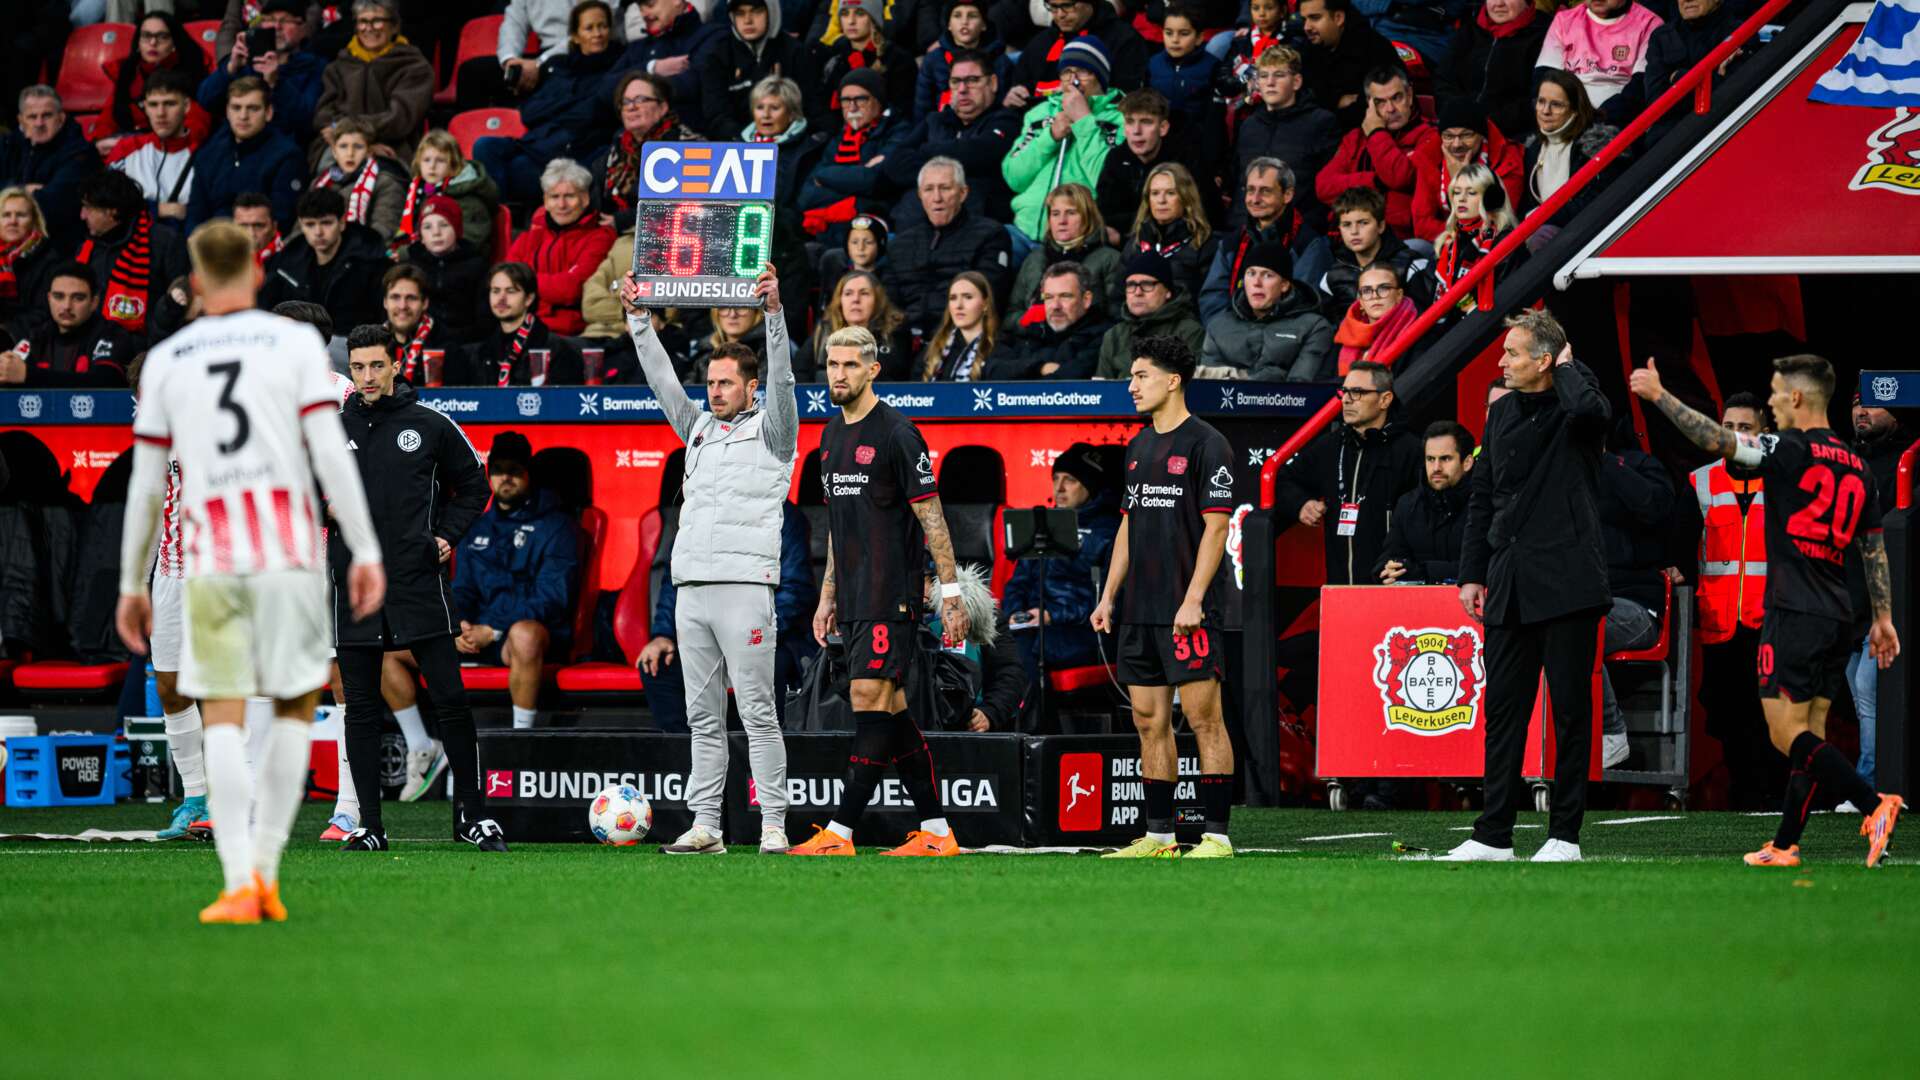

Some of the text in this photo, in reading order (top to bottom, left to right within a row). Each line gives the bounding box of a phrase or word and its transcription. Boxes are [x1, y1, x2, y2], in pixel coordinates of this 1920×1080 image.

[644, 148, 774, 193] CEAT
[670, 206, 770, 277] 6 8
[654, 282, 758, 297] BUNDESLIGA
[207, 359, 250, 455] 3
[997, 392, 1102, 406] BarmeniaGothaer
[1237, 392, 1306, 407] BarmeniaGothaer
[1142, 484, 1183, 496] Barmenia
[1141, 497, 1175, 508] Gothaer
[1786, 463, 1866, 549] 20
[872, 624, 889, 654] 8
[1173, 627, 1209, 661] 30
[1419, 638, 1443, 648] 1904
[1409, 677, 1453, 687] BAYER
[1395, 709, 1466, 727] Leverkusen
[62, 757, 99, 772] POWER
[138, 756, 158, 765] AOK
[1112, 758, 1135, 776] DIE
[1111, 806, 1139, 824] APP
